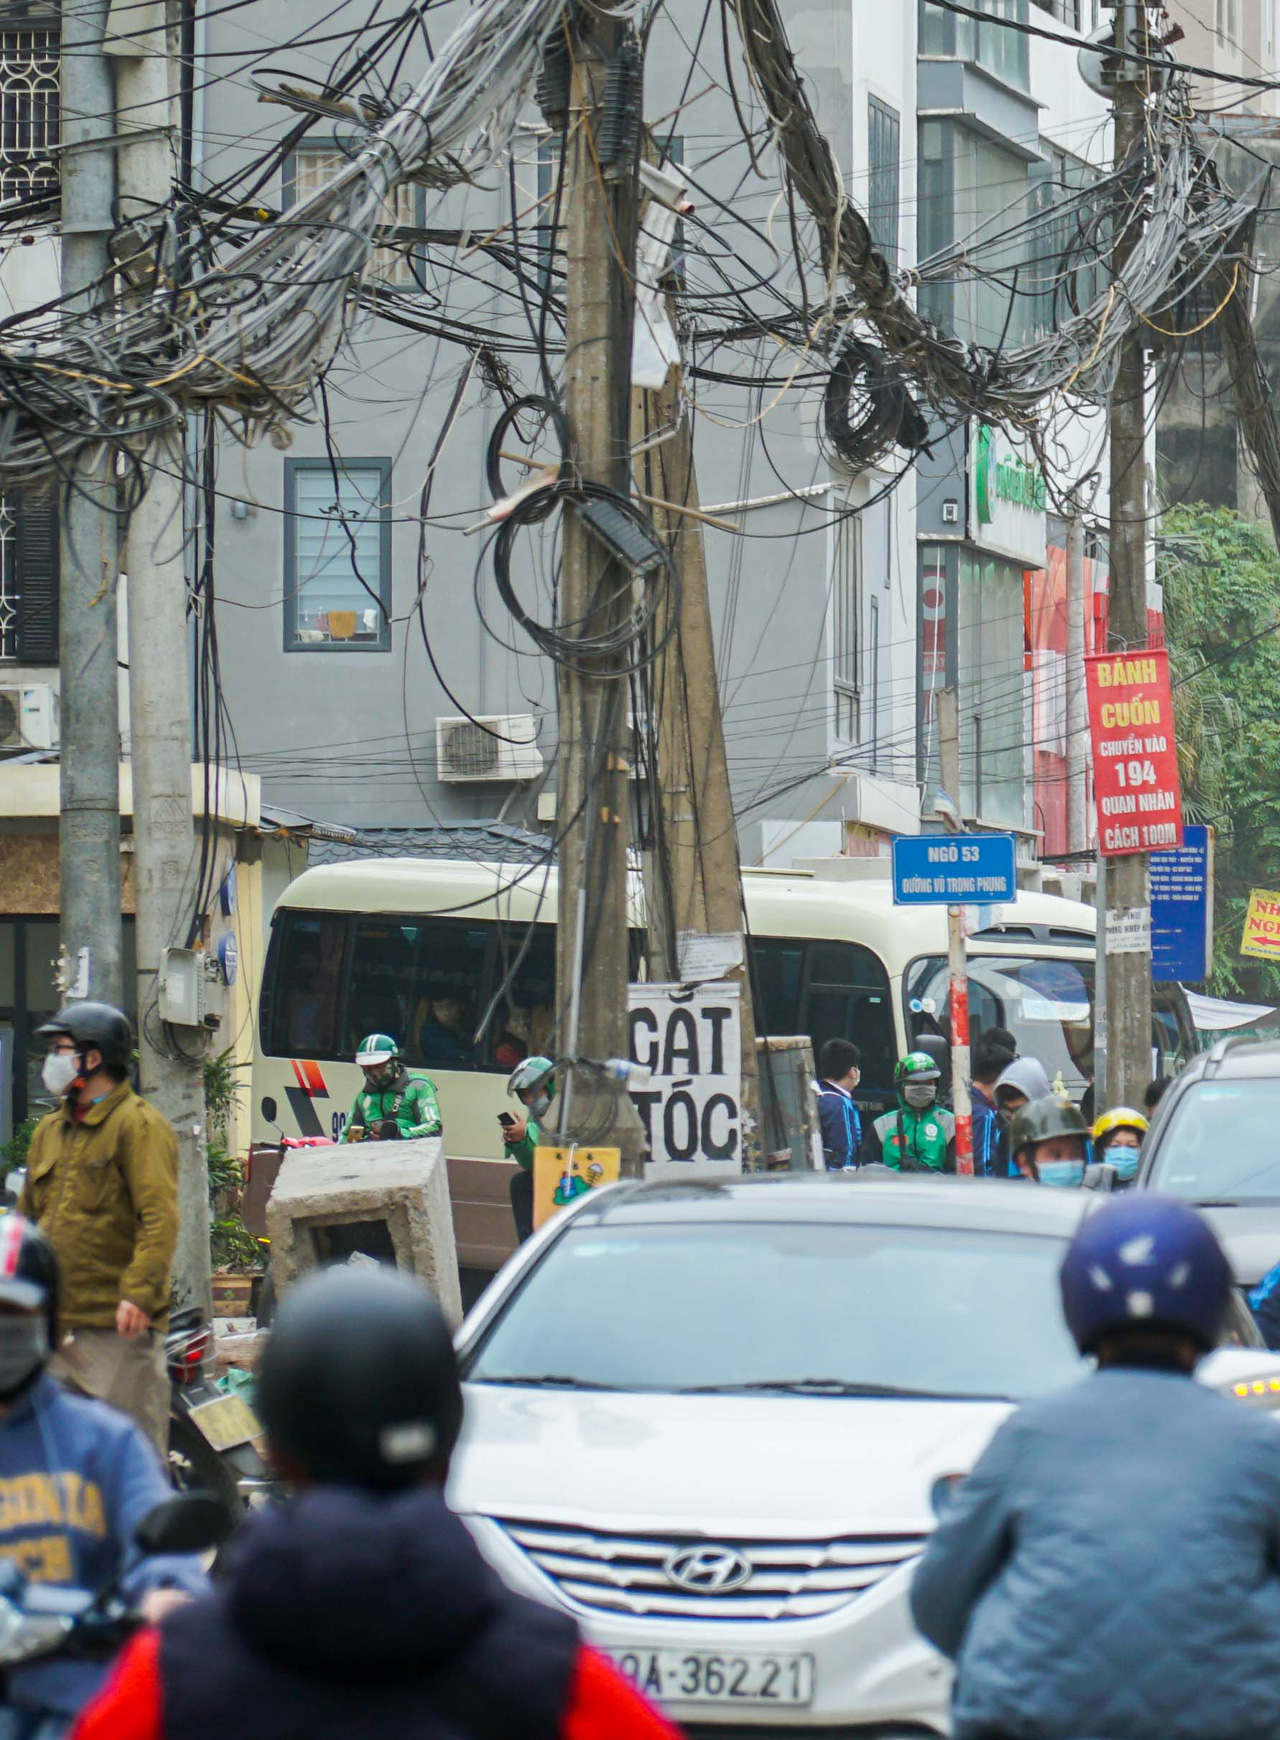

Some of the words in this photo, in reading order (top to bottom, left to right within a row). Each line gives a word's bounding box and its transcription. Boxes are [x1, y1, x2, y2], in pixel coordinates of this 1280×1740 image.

[1097, 657, 1157, 687] BÁNH
[1101, 693, 1160, 728] CUỐN
[1145, 734, 1167, 753] VÀO
[1114, 760, 1157, 787] 194
[1102, 795, 1136, 816] QUAN
[1138, 789, 1175, 811] NHÂN
[1105, 824, 1139, 849] CÁCH
[1142, 823, 1177, 846] 100M
[928, 842, 958, 862] NGÕ
[961, 846, 980, 861] 53
[332, 1111, 350, 1142] 90
[630, 1079, 738, 1162] TÓC
[606, 1652, 801, 1699] 9A-362.21
